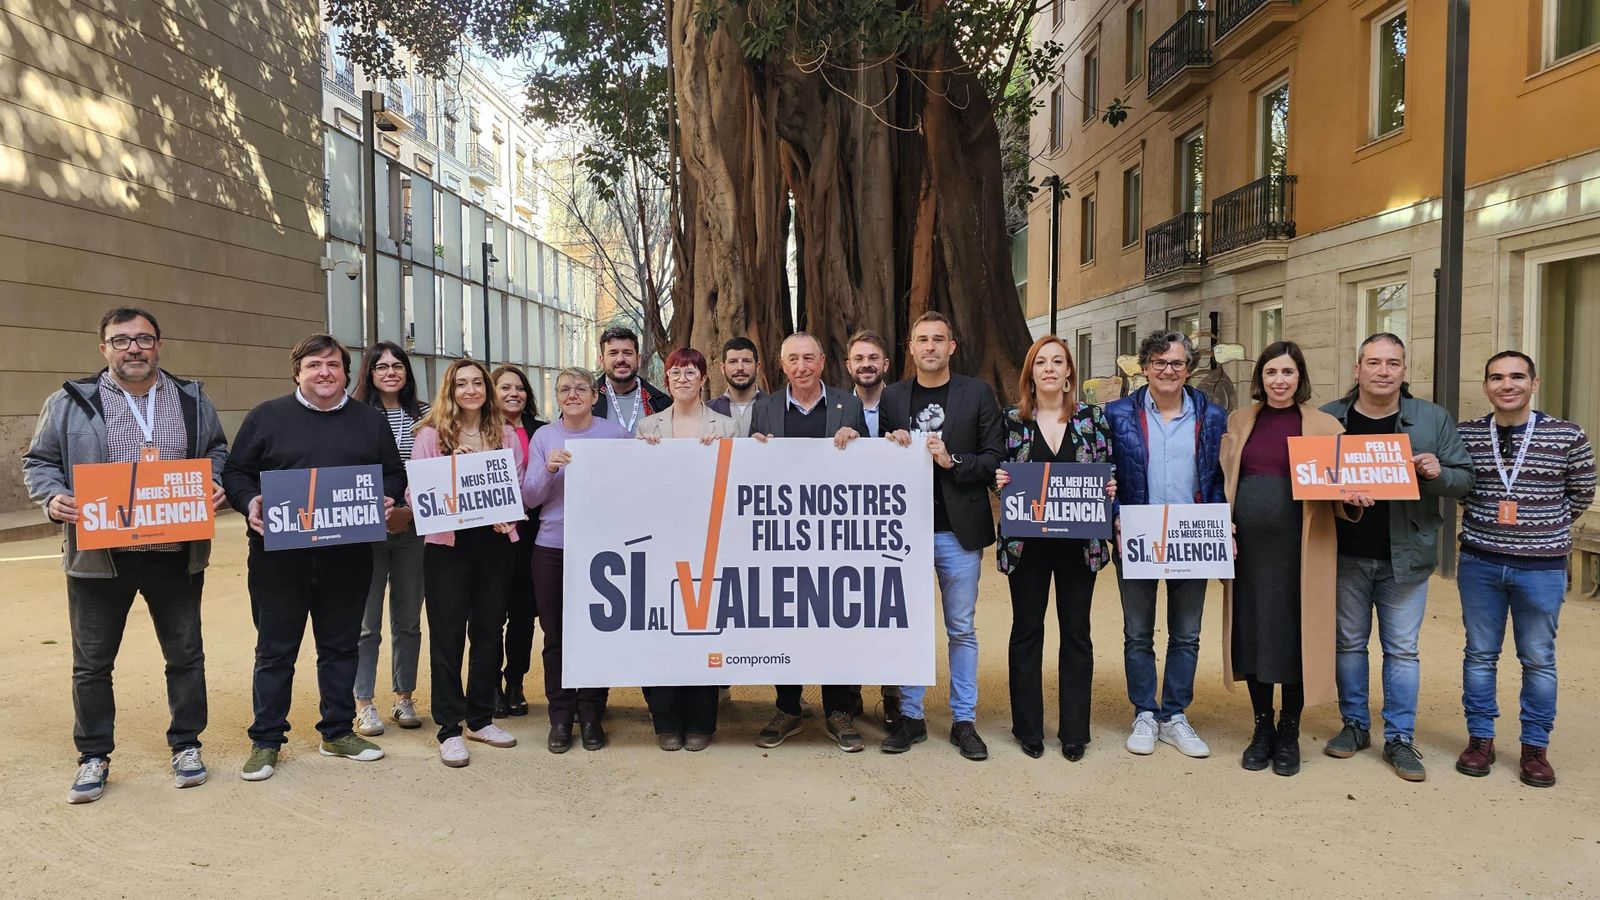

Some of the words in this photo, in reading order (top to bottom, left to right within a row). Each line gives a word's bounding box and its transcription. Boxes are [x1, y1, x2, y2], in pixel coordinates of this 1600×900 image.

[1365, 441, 1385, 452] PER
[1388, 441, 1401, 452] LA
[486, 458, 508, 472] PELS
[1344, 453, 1374, 464] MEUA
[1375, 452, 1407, 464] FILLA,
[163, 472, 183, 485] PER
[185, 471, 202, 484] LES
[460, 473, 486, 488] MEUS
[487, 470, 513, 485] FILLS,
[1296, 459, 1317, 485] SÍ
[1326, 462, 1411, 484] VALENCIÀ
[356, 474, 374, 487] PEL
[1050, 476, 1064, 487] PEL
[1065, 476, 1082, 487] MEU
[1083, 476, 1099, 487] FILL
[1099, 476, 1104, 487] I
[136, 486, 170, 500] MEUES
[172, 484, 207, 499] FILLES,
[332, 488, 354, 502] MEU
[355, 487, 378, 501] FILL,
[1048, 487, 1058, 498] LA
[1059, 487, 1081, 498] MEUA
[1082, 487, 1106, 500] FILLA,
[417, 487, 438, 518] SÍ
[444, 483, 517, 514] VALENCIÀ
[737, 484, 793, 516] PELS
[799, 484, 907, 516] NOSTRES
[1005, 491, 1026, 521] SÍ
[1032, 499, 1106, 522] VALENCIÀ
[82, 496, 108, 531] SÍ
[118, 496, 208, 528] VALENCIÀ
[268, 500, 291, 533] SÍ
[298, 501, 380, 530] VALENCIÀ
[1179, 520, 1191, 529] PEL
[1192, 520, 1206, 529] MEU
[1207, 520, 1220, 528] FILL
[752, 519, 811, 551] FILLS
[818, 519, 825, 551] I
[831, 519, 912, 556] FILLES,
[1168, 529, 1180, 539] LES
[1181, 529, 1202, 538] MEUES
[1203, 529, 1226, 539] FILLES,
[1127, 534, 1146, 562] SÍ
[1153, 539, 1228, 563] VALENCIÀ
[588, 535, 653, 632] SÍ
[647, 606, 669, 631] AL
[675, 553, 909, 630] VALENCIÀ
[725, 652, 791, 667] compromís
